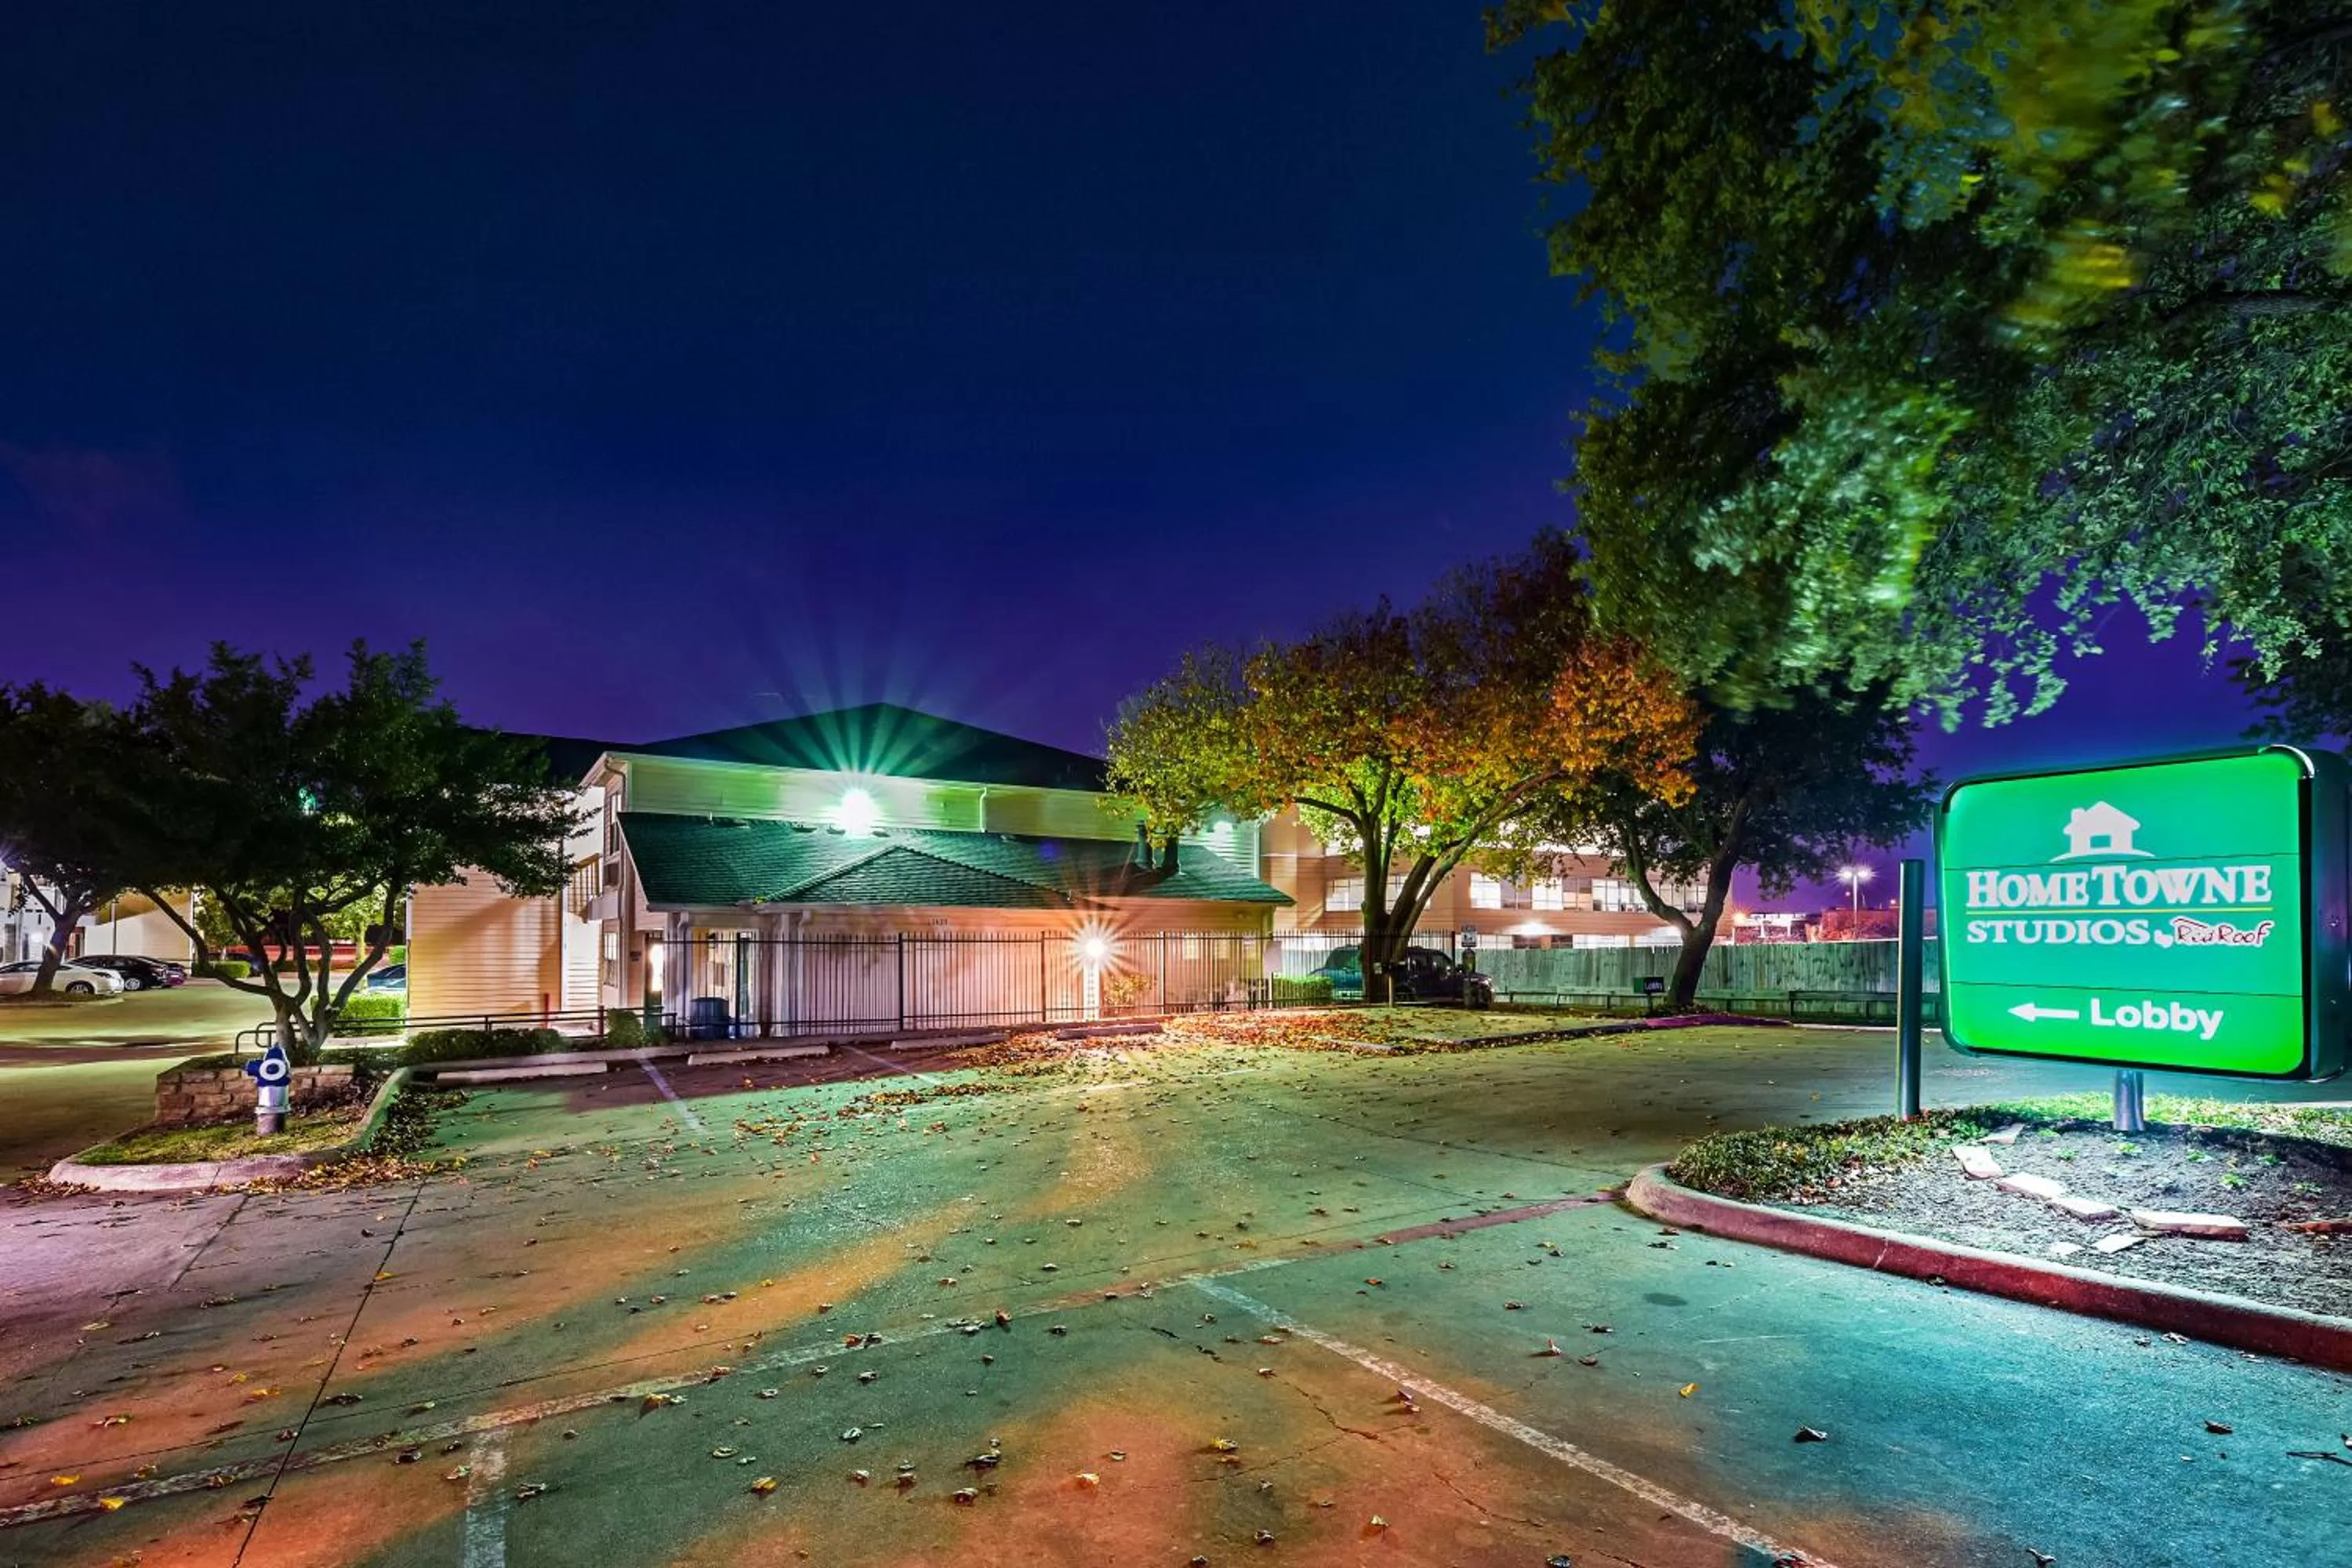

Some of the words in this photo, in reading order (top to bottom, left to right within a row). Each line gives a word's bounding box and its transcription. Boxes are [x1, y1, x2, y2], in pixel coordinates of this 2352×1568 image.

[1966, 865, 2272, 906] HOMETOWNE
[1967, 919, 2151, 944] STUDIOS
[2216, 920, 2274, 946] Roof
[2091, 997, 2224, 1040] Lobby
